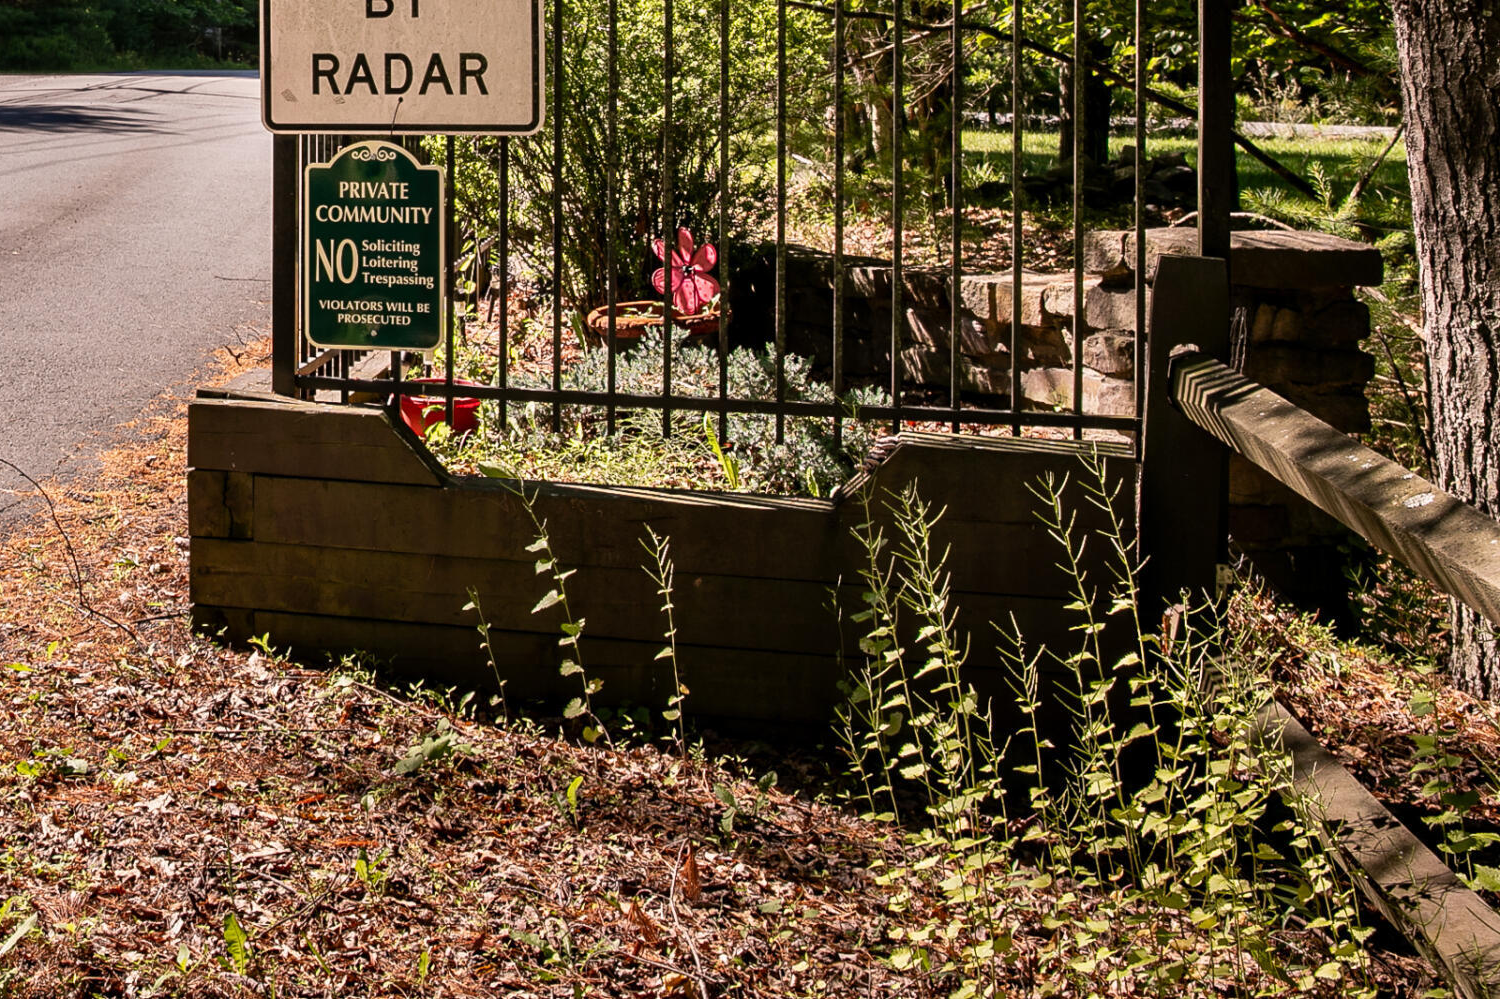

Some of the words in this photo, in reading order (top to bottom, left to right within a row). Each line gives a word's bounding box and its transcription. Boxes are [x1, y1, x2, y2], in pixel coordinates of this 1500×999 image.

[311, 53, 489, 96] RADAR
[339, 181, 409, 200] PRIVATE
[315, 204, 433, 224] COMMUNITY
[362, 239, 421, 256] Soliciting
[315, 238, 359, 284] NO
[362, 256, 418, 272] Loitering
[362, 272, 434, 289] Trespassing
[319, 299, 383, 312] VIOLATORS
[386, 301, 414, 313] WILL
[416, 303, 431, 313] BE
[337, 313, 411, 326] PROSECUTED
